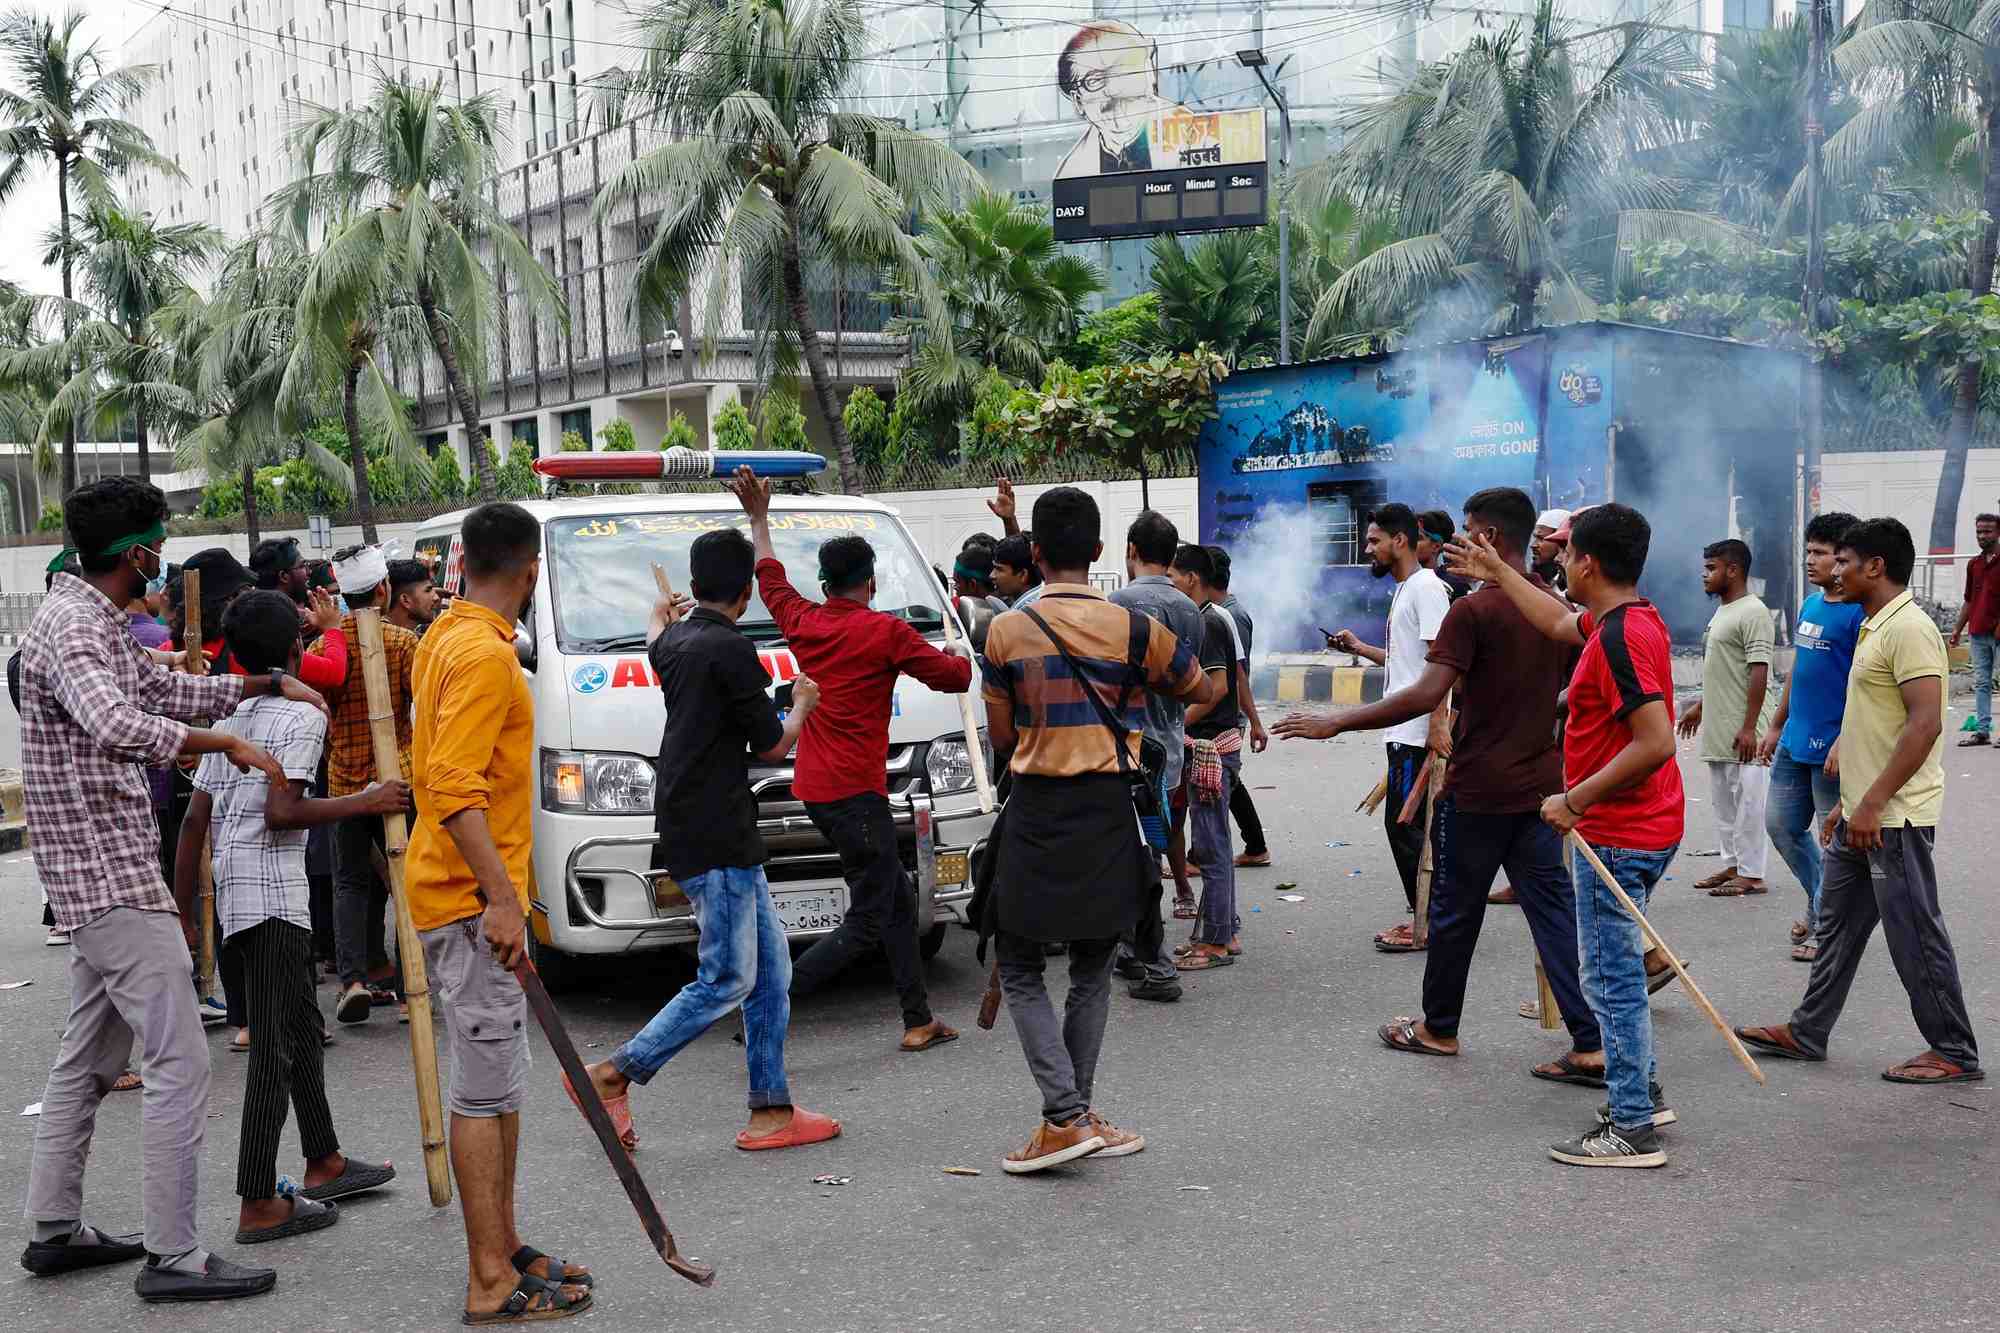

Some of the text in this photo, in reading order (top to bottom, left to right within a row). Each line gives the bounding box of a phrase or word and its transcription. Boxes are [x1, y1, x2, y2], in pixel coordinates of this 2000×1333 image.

[1145, 176, 1252, 193] Hour Minute Sec
[1056, 206, 1085, 217] DAYS
[1502, 420, 1525, 435] ON
[1500, 438, 1539, 455] GONE
